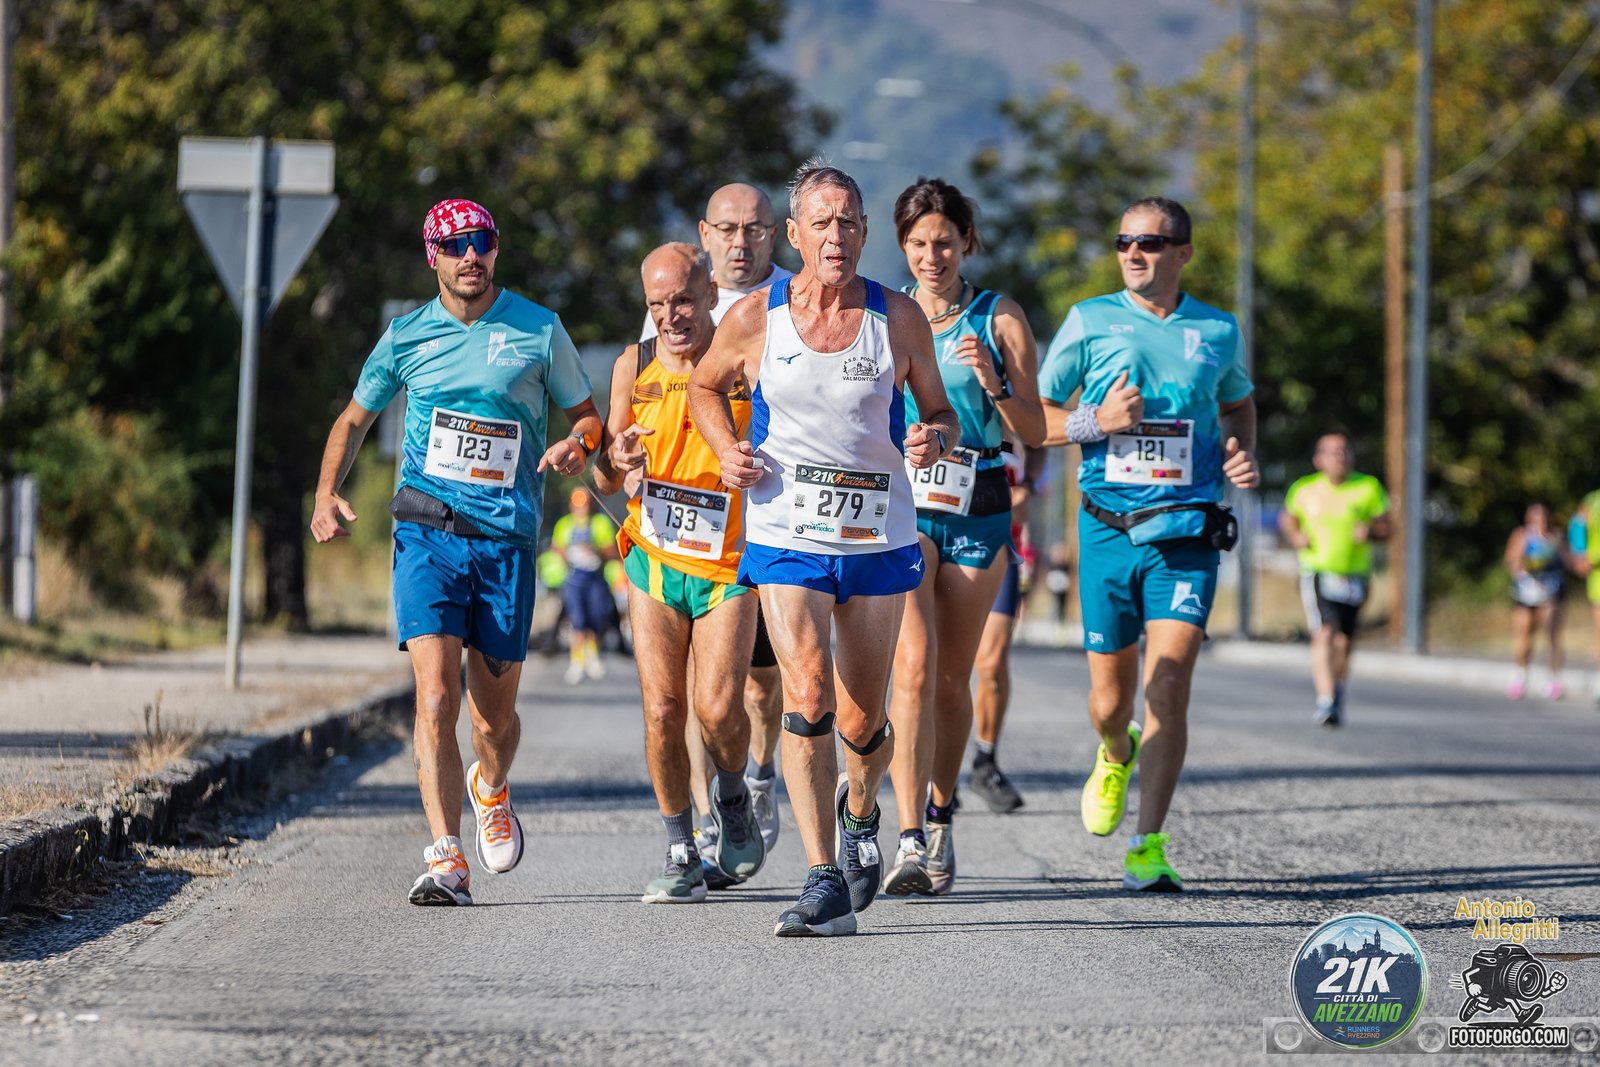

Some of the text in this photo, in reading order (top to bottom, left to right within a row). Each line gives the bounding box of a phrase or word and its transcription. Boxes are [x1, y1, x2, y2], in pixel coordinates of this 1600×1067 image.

[448, 417, 470, 431] 21K
[456, 434, 492, 461] 123
[1136, 438, 1165, 461] 121
[811, 469, 837, 484] 21K
[817, 489, 864, 520] 279
[665, 504, 698, 532] 133
